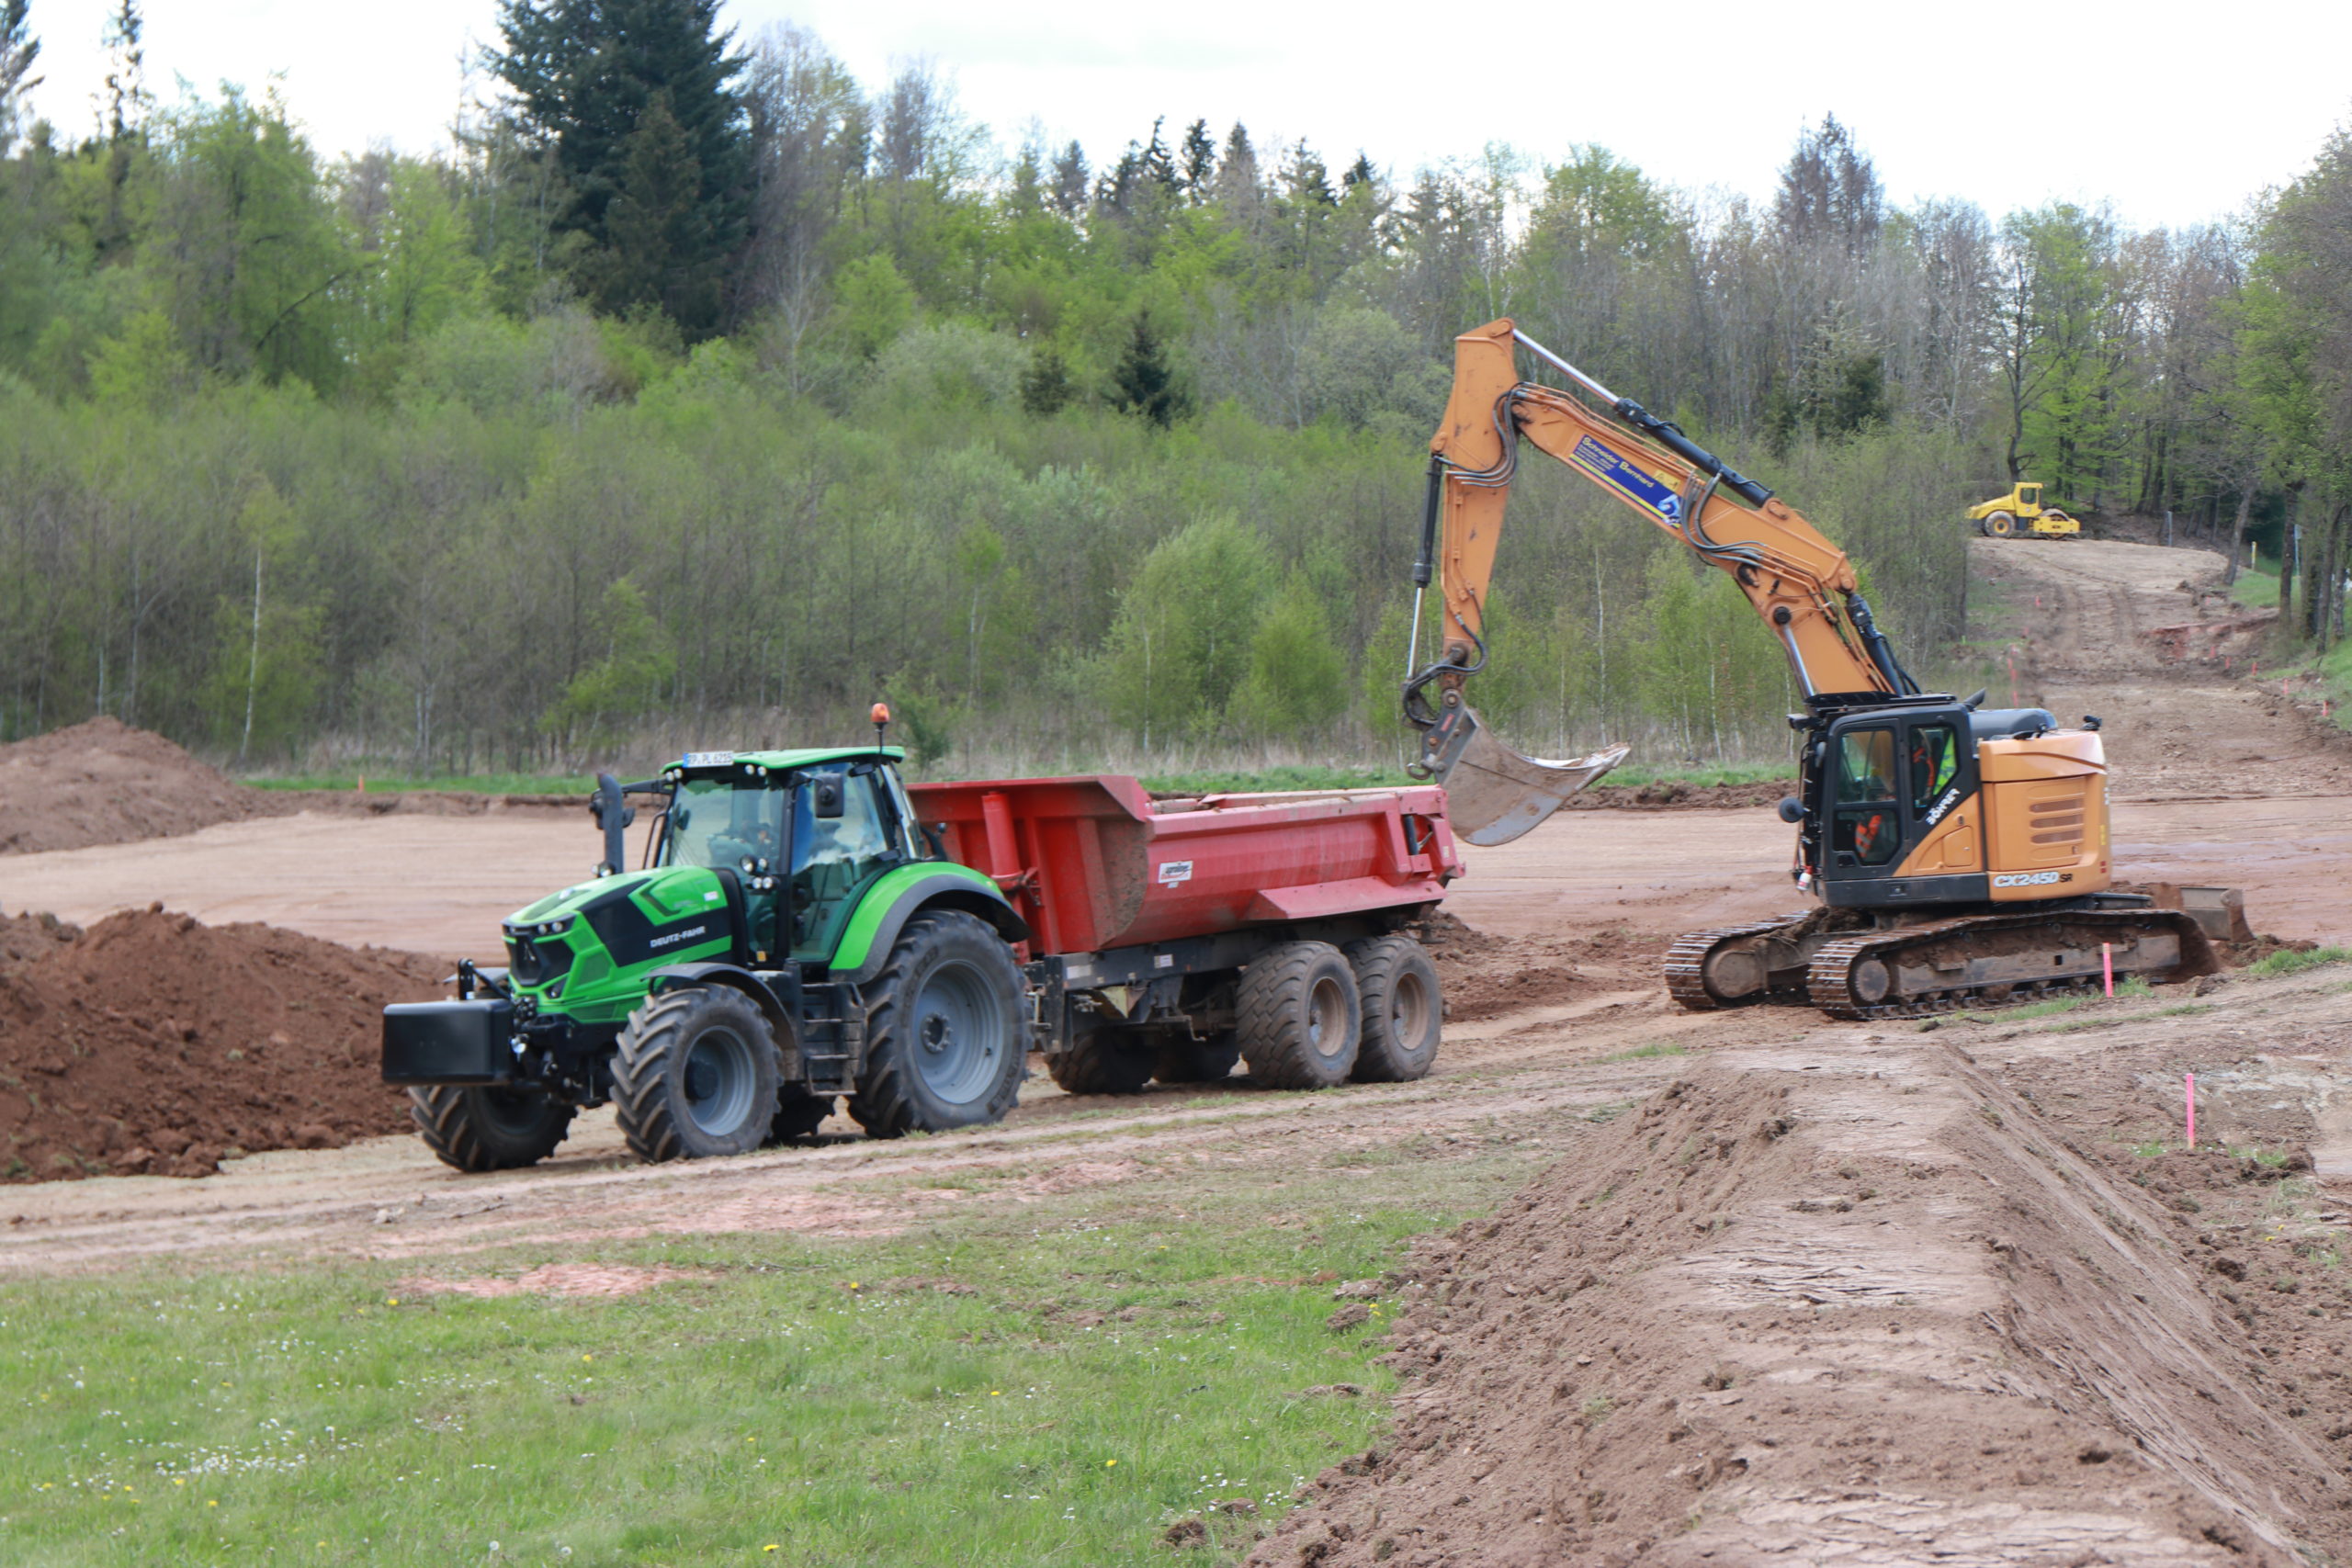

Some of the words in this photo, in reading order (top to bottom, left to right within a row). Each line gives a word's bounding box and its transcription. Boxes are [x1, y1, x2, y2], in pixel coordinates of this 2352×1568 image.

[1582, 436, 1619, 464] Schneider
[1619, 461, 1655, 488] Bernhard
[1994, 872, 2059, 887] CX245D
[2060, 874, 2074, 883] SR
[650, 925, 706, 948] DEUTZ-FAHR
